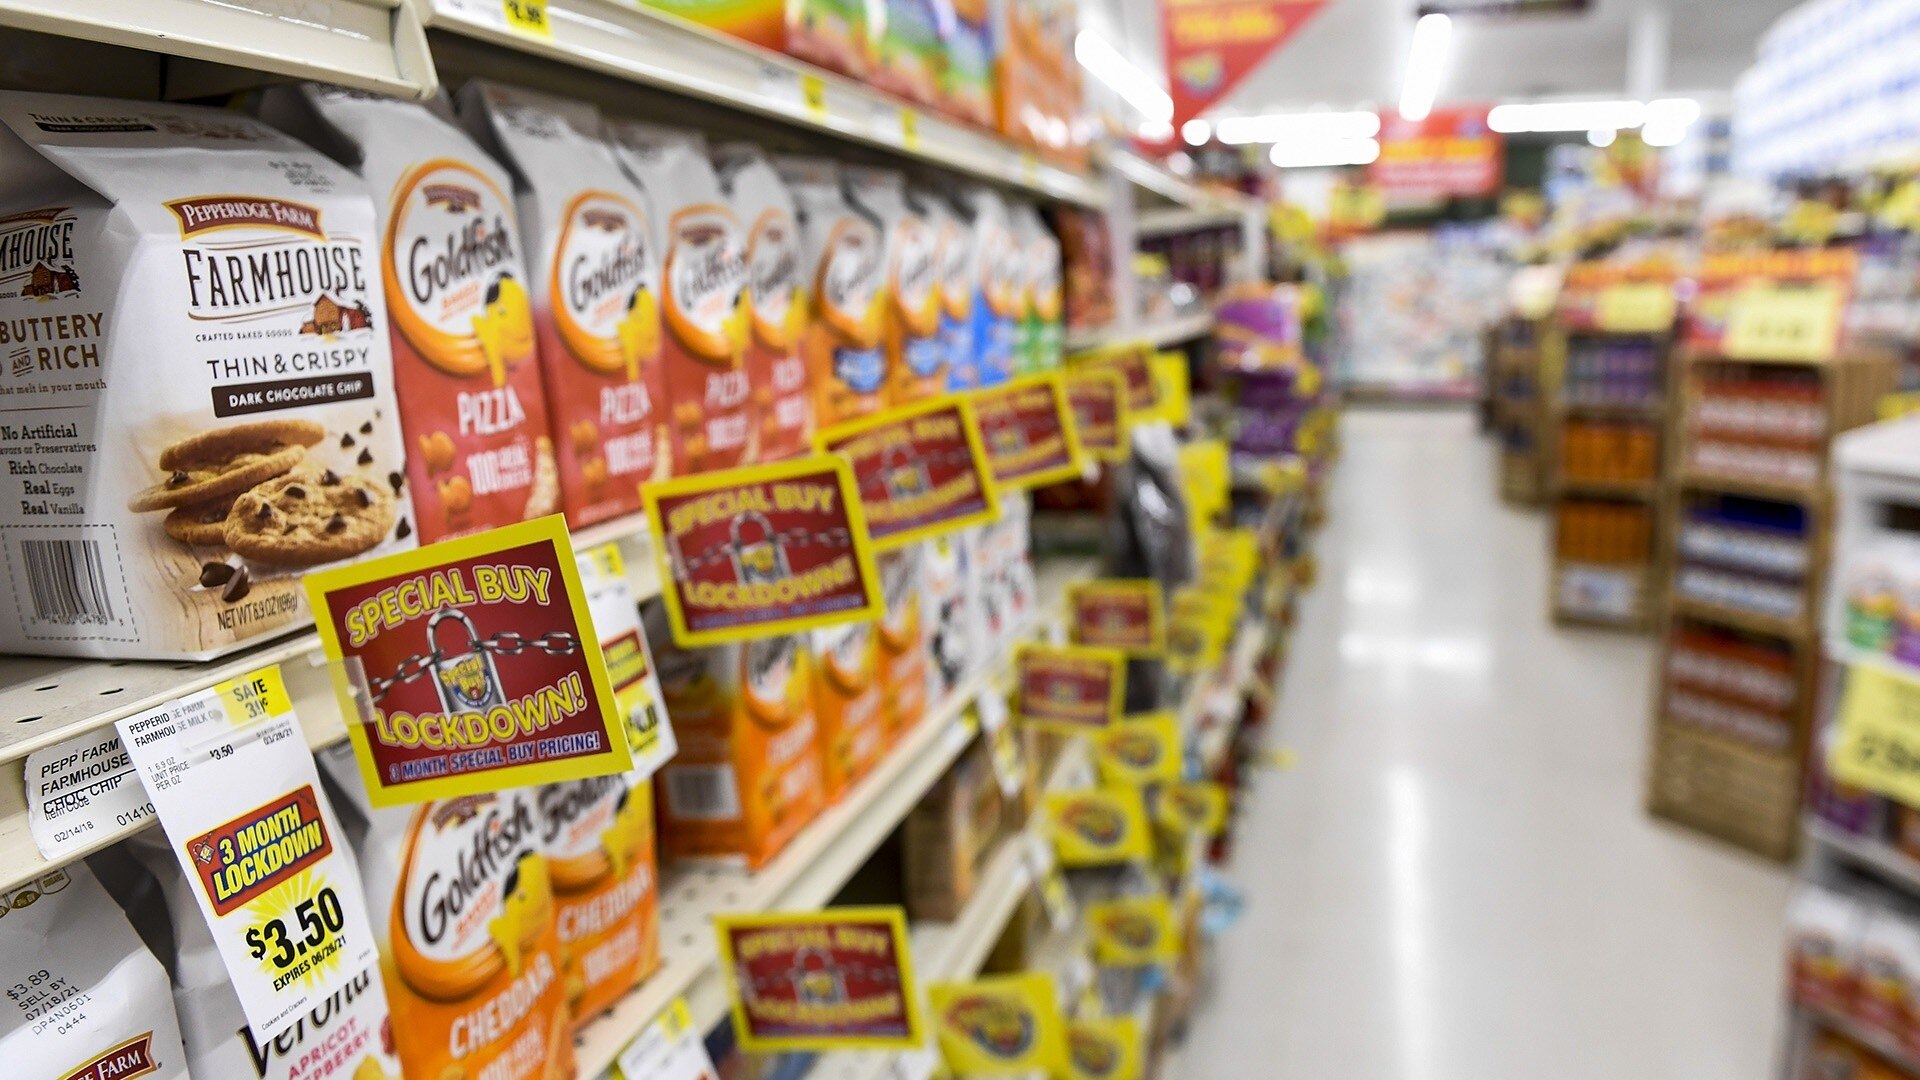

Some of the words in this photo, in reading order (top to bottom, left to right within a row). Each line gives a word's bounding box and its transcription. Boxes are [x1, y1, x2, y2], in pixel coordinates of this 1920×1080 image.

[182, 202, 271, 227] PEPPERIDGE
[270, 201, 314, 229] FARM
[410, 214, 514, 303] Goldfish
[183, 247, 365, 307] FARMHOUSE
[0, 313, 103, 344] BUTTERY
[196, 332, 234, 342] CRAFTED
[237, 331, 262, 339] BAKED
[12, 354, 31, 372] AND
[37, 344, 99, 371] RICH
[207, 355, 268, 379] THIN
[275, 354, 288, 374] &
[292, 348, 370, 372] CRISPY
[38, 383, 49, 393] in
[51, 384, 72, 395] your
[75, 379, 107, 390] mouth
[229, 392, 263, 408] DARK
[266, 384, 334, 402] CHOCOLATE
[337, 380, 363, 395] CHIP
[457, 386, 526, 437] PIZZA
[1, 426, 18, 440] No
[21, 423, 78, 439] Artificial
[35, 443, 96, 454] Preservatives
[9, 460, 37, 475] Rich
[38, 463, 83, 475] Chocolate
[23, 480, 51, 495] Real
[52, 483, 75, 496] Eggs
[21, 501, 48, 515] Real
[50, 503, 85, 515] Vanilla
[669, 487, 769, 537] SPECIAL
[773, 484, 836, 515] BUY
[217, 608, 236, 630] NET
[236, 603, 252, 625] WT
[266, 596, 276, 617] OZ
[346, 569, 476, 648] SPECIAL
[473, 564, 552, 605] BUY
[375, 670, 589, 749] LOCKDOWN!
[41, 754, 78, 778] PEPP
[81, 738, 119, 763] FARM
[210, 744, 235, 761] $3.50
[401, 755, 448, 780] MONTH
[451, 746, 505, 771] SPECIAL
[508, 740, 536, 762] BUY
[538, 731, 600, 756] PRICING!
[41, 752, 129, 796] FARMHOUSE
[151, 770, 169, 783] UNIT
[169, 761, 190, 773] PRICE
[156, 780, 172, 791] PER
[172, 774, 182, 786] OZ
[43, 790, 87, 815] CHOC
[89, 775, 123, 797] CHIP
[54, 820, 94, 843] 02/14/18
[220, 837, 236, 865] 3
[236, 802, 302, 855] MONTH
[213, 820, 323, 901] LOCKDOWN
[421, 793, 535, 945] Goldfish
[246, 887, 345, 969] $3.50
[7, 969, 51, 1001] $3.89
[273, 959, 311, 992] EXPIRES
[18, 991, 49, 1011] SELL
[49, 977, 67, 991] BY
[25, 985, 81, 1021] 07/18/21
[450, 951, 555, 1060] CHEDDAR
[57, 1012, 87, 1036] 0444
[289, 1016, 356, 1080] APRICOT
[97, 1050, 142, 1080] FARM
